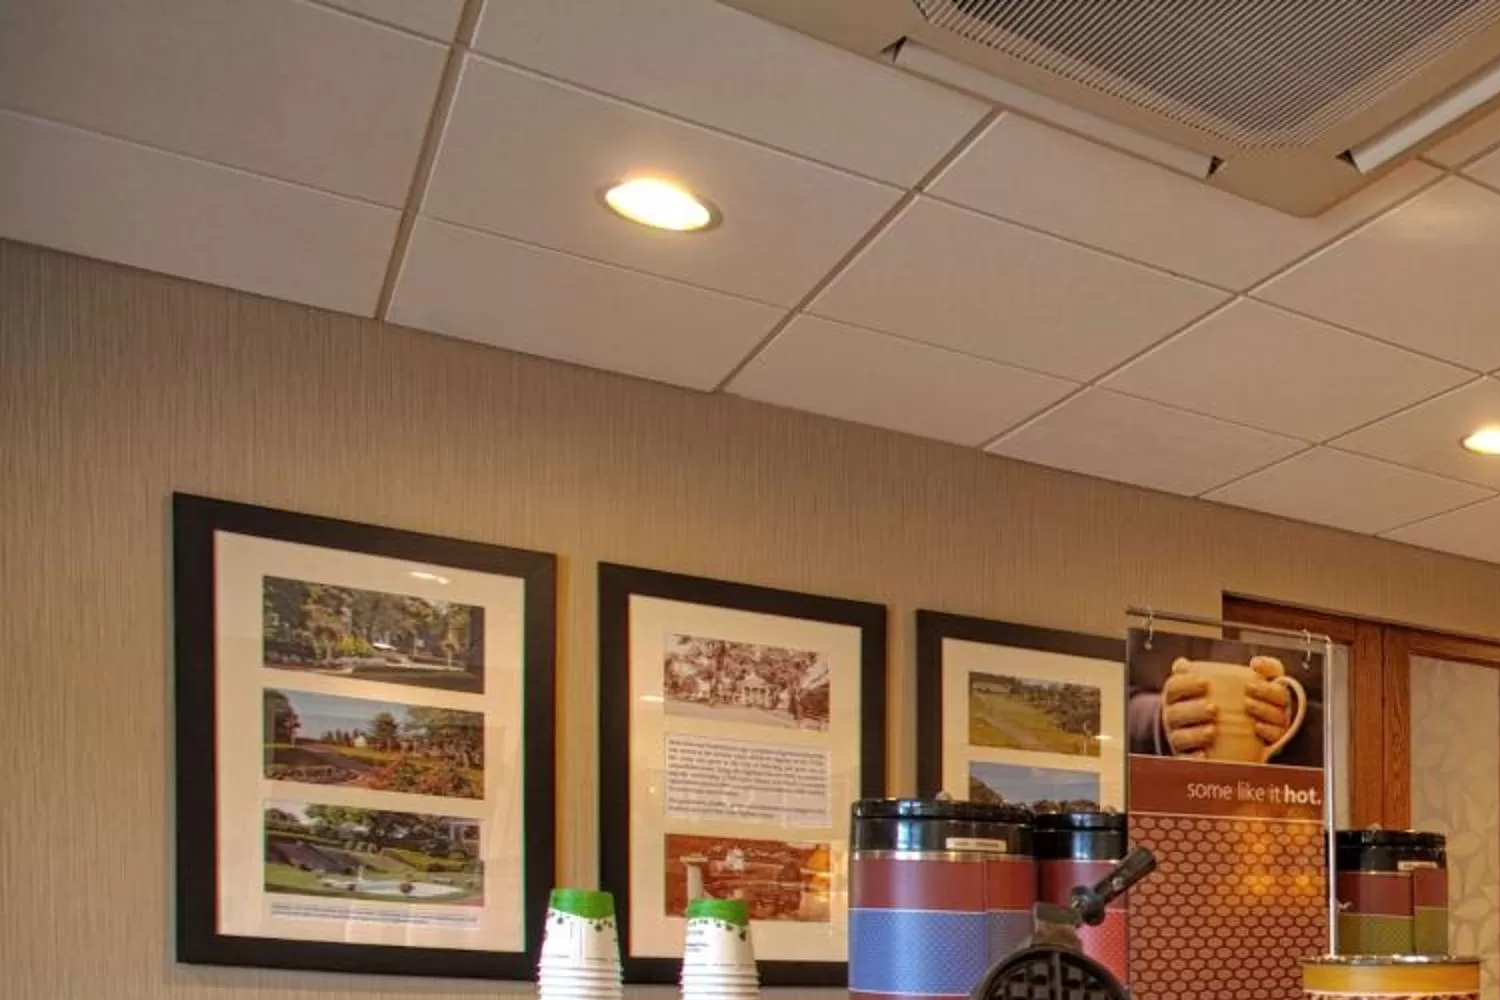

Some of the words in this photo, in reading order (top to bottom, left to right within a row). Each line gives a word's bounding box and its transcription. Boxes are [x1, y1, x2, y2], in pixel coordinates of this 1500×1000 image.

[1187, 783, 1232, 801] some
[1237, 779, 1265, 801] like
[1269, 783, 1282, 804] it
[1283, 784, 1322, 805] hot.
